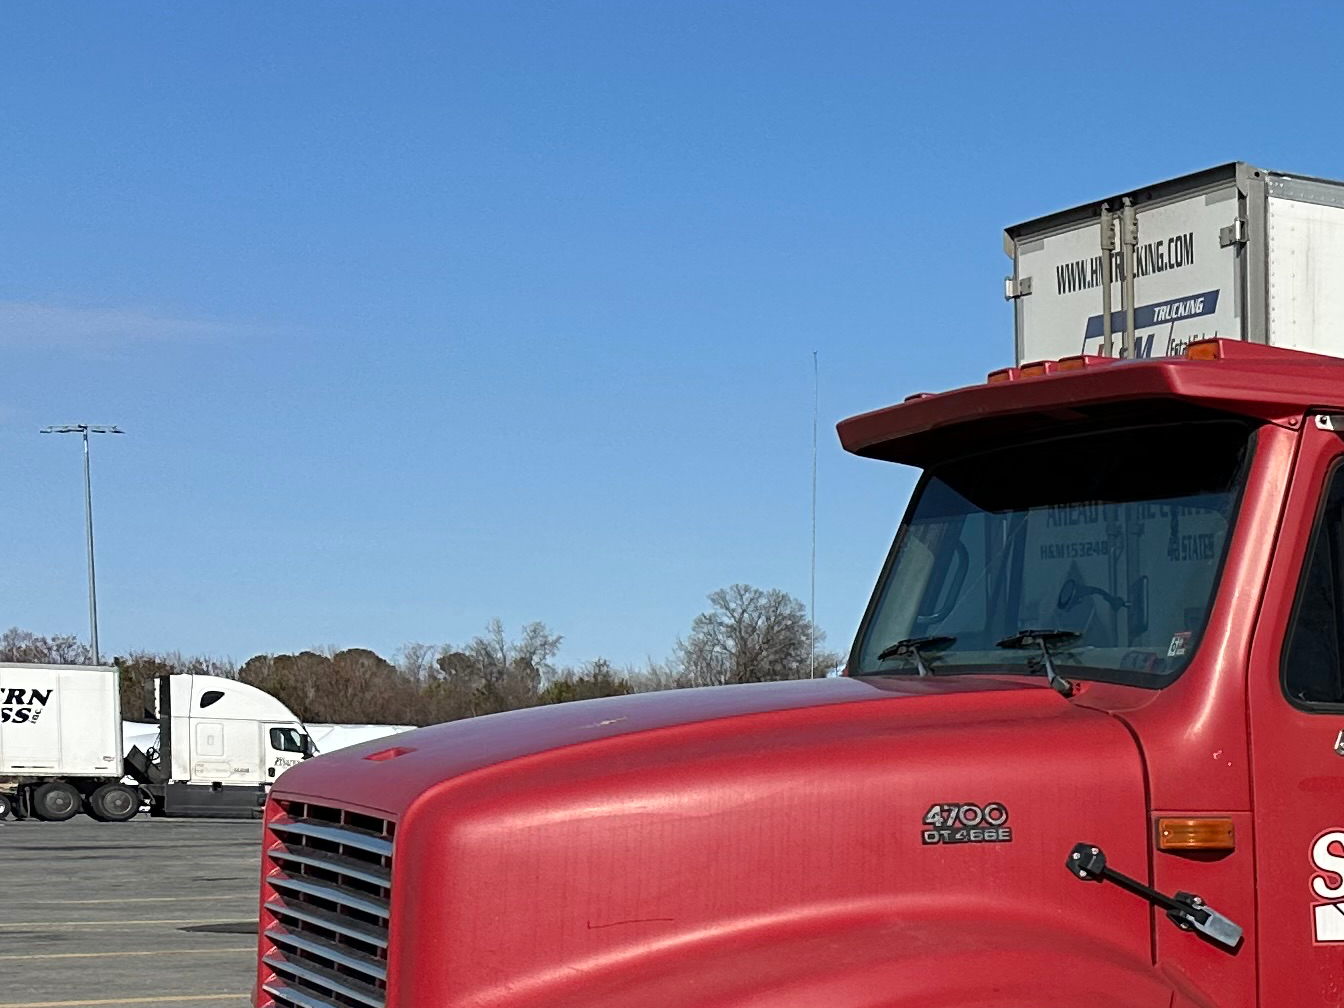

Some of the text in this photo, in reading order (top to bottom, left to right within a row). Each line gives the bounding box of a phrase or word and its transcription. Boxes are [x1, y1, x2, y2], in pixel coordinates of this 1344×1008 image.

[1153, 297, 1204, 323] TRUCKING
[0, 688, 54, 707] RN
[925, 804, 1008, 827] 4700
[923, 828, 1011, 843] DT 466E
